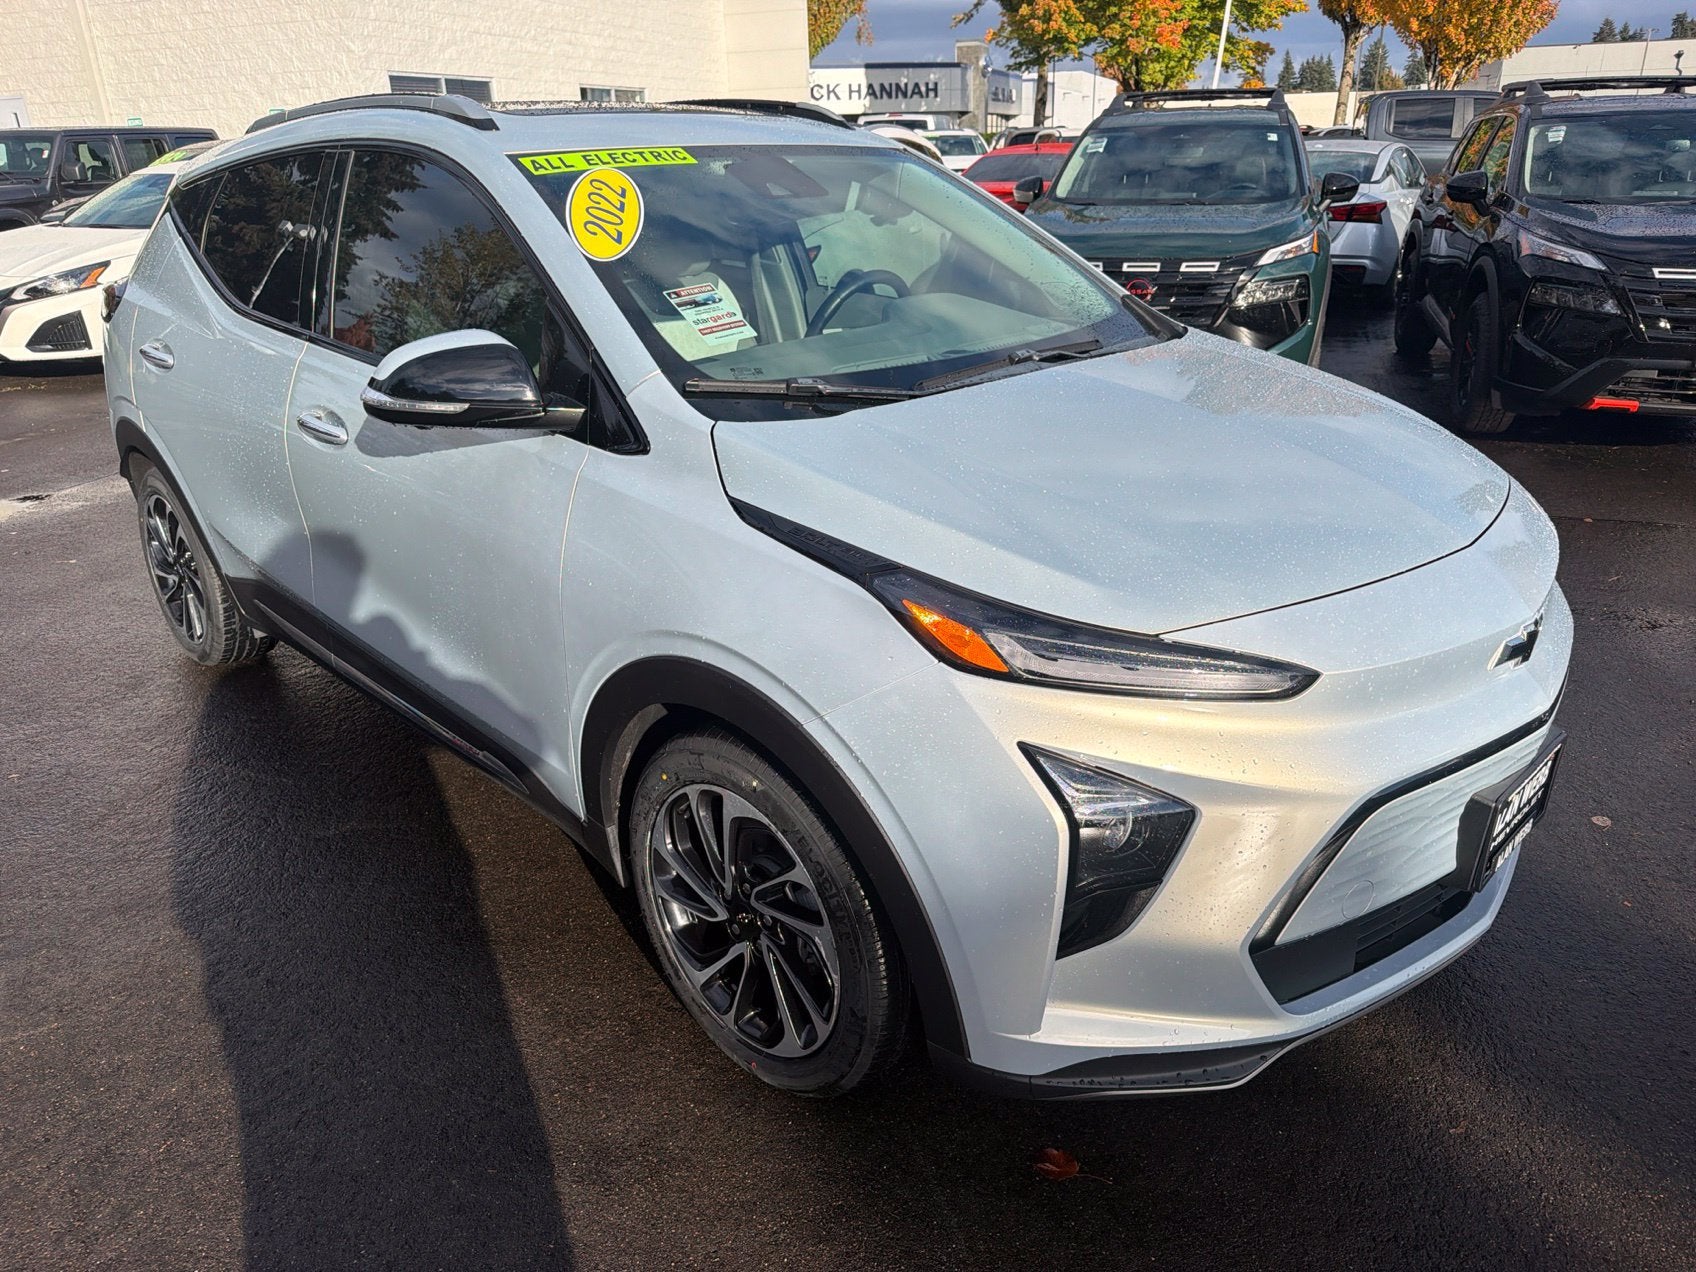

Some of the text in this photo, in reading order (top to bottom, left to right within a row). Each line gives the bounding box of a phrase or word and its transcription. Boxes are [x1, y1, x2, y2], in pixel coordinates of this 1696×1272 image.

[848, 81, 939, 101] HANNAH
[529, 149, 688, 172] ALL ELECTRIC
[583, 178, 627, 245] 2022
[680, 286, 713, 297] ATTENTION
[1490, 788, 1544, 852] HEVROLET
